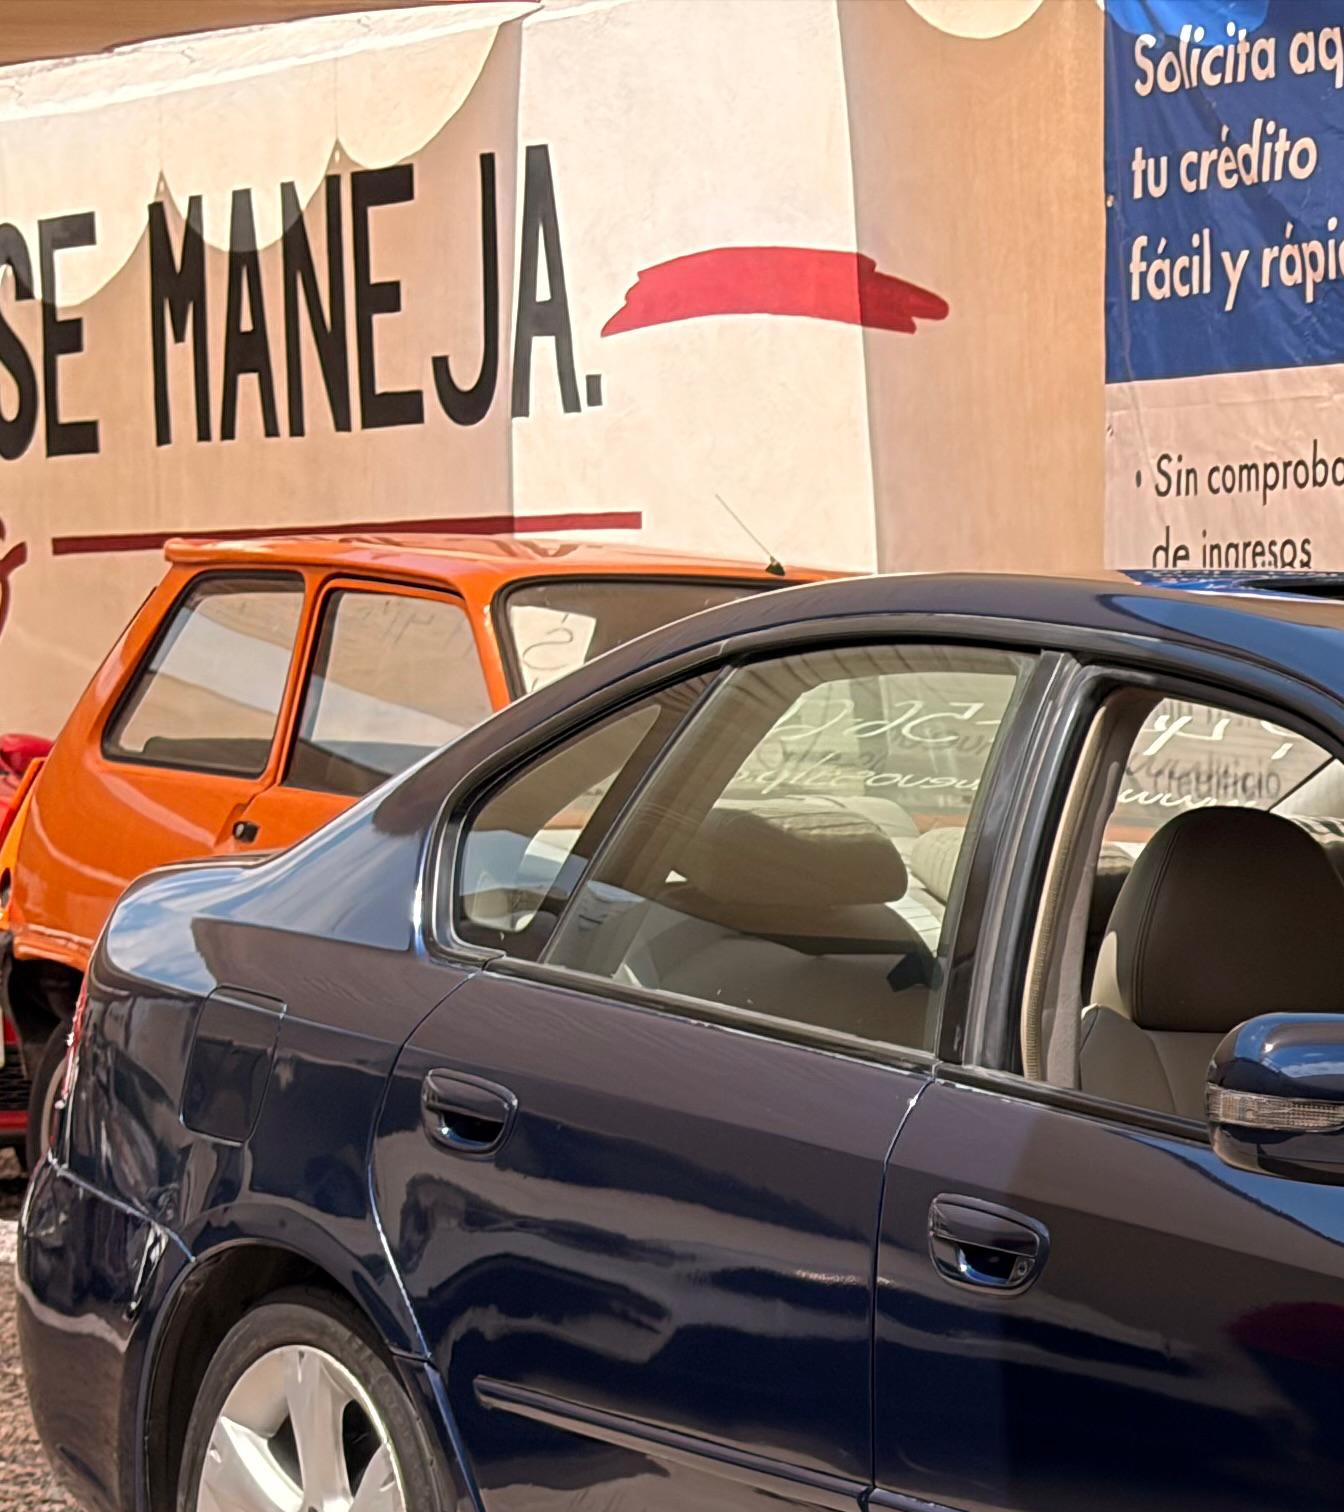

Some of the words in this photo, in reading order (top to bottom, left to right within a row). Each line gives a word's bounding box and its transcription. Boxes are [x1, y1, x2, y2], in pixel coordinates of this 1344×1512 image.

[1134, 22, 1276, 97] Solicita
[1131, 146, 1168, 199] tu
[1179, 117, 1318, 193] crédito
[148, 144, 602, 447] MANEJA.
[1129, 227, 1211, 302] fácil
[1220, 249, 1250, 312] y
[1154, 453, 1198, 498] Sin
[1152, 525, 1190, 568] de
[1202, 529, 1312, 569] ingresos
